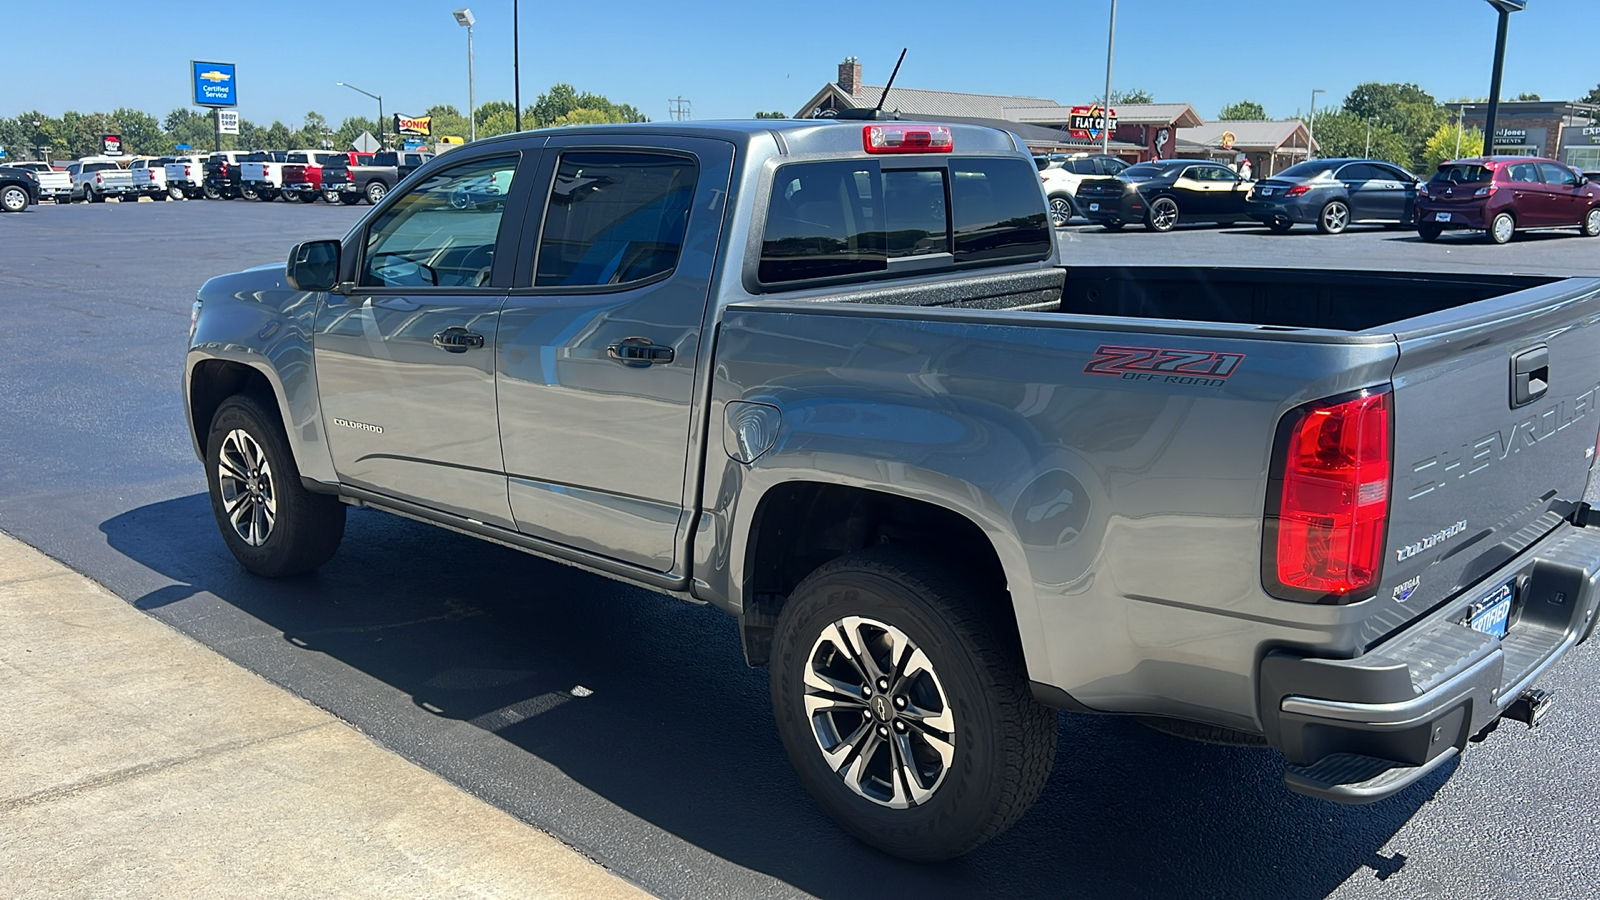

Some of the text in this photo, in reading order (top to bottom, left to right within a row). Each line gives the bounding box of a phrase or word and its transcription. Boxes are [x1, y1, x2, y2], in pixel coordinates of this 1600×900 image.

[203, 85, 229, 93] Certified
[401, 120, 428, 129] SONIC
[1076, 117, 1116, 129] FLAT CREK
[1082, 344, 1246, 378] Z71
[1122, 372, 1226, 387] OFF ROAD
[334, 418, 384, 433] COLORADO
[1396, 519, 1467, 562] COLORADO
